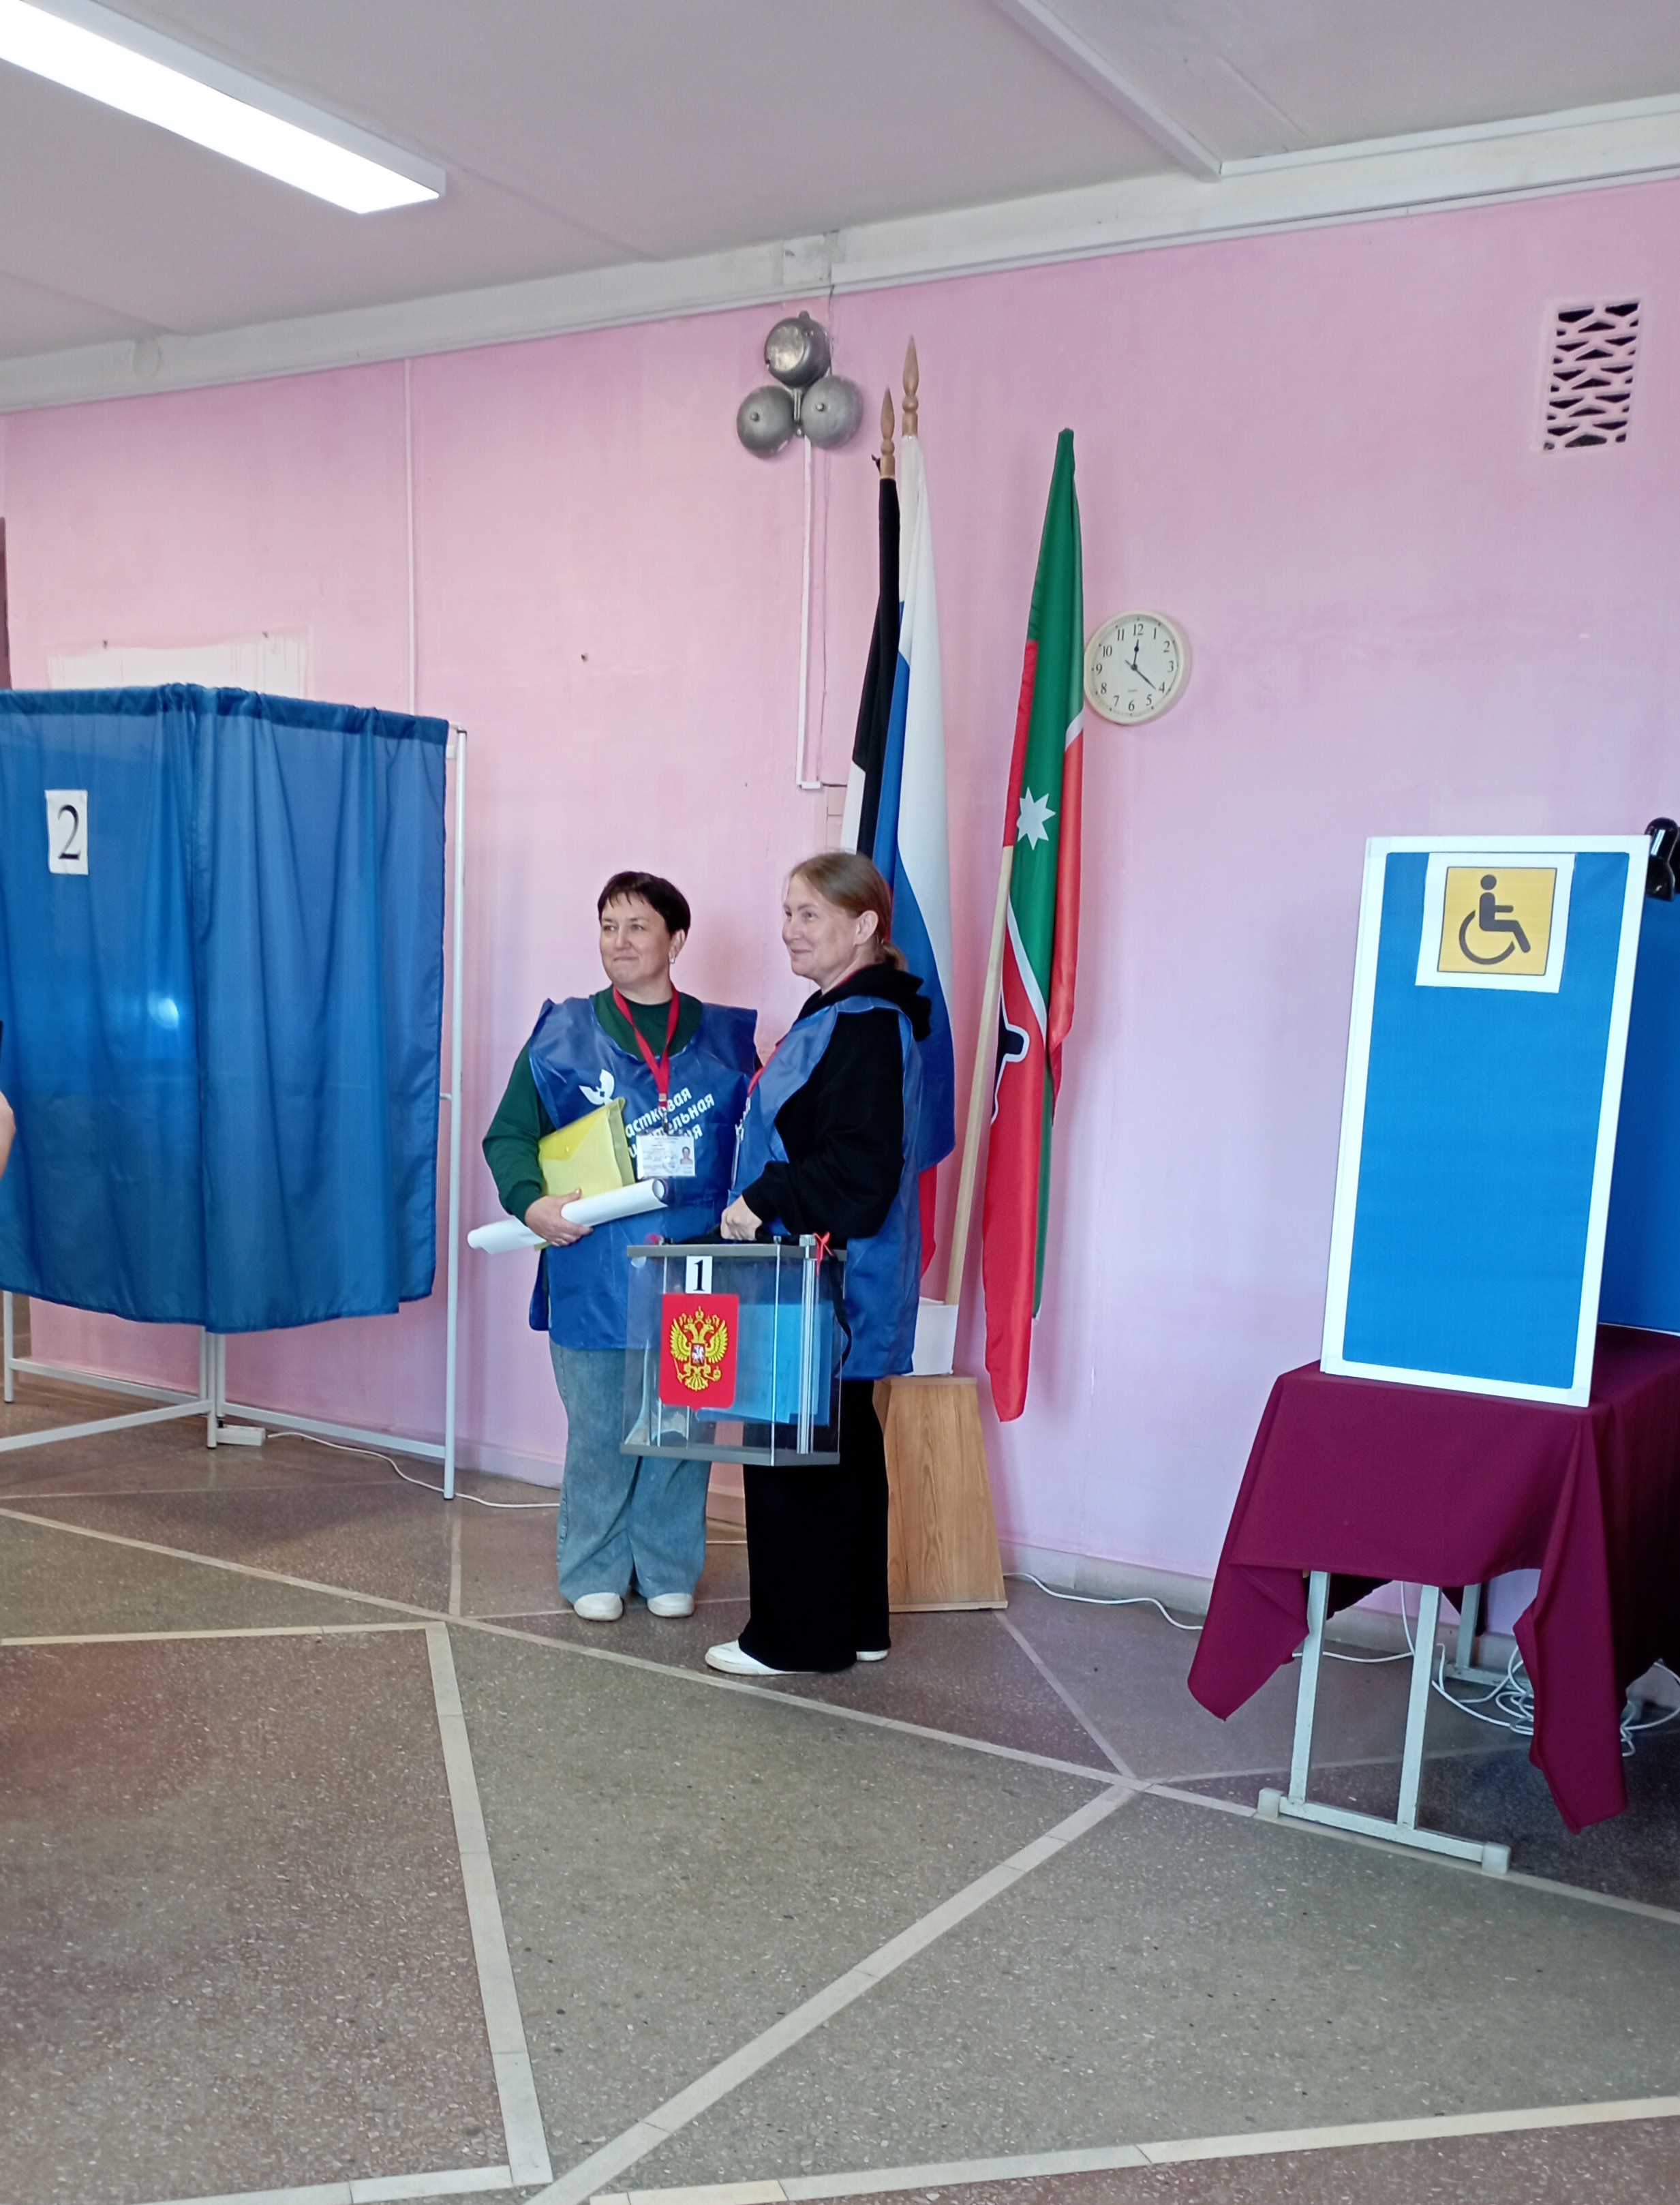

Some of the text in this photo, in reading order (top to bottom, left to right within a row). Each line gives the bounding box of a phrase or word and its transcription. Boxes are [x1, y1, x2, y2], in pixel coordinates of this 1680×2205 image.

[1117, 628, 1125, 641] 11
[1133, 623, 1144, 636] 12
[1153, 627, 1157, 639] 1
[1102, 645, 1112, 657] 10
[1163, 641, 1170, 653] 2
[1095, 663, 1103, 674] 9
[1167, 660, 1174, 673] 3
[1100, 682, 1107, 694] 8
[1159, 682, 1165, 693] 4
[1113, 695, 1120, 708] 7
[1128, 699, 1135, 712] 6
[1146, 694, 1152, 706] 5
[57, 804, 81, 860] 2
[693, 1259, 706, 1292] 1
